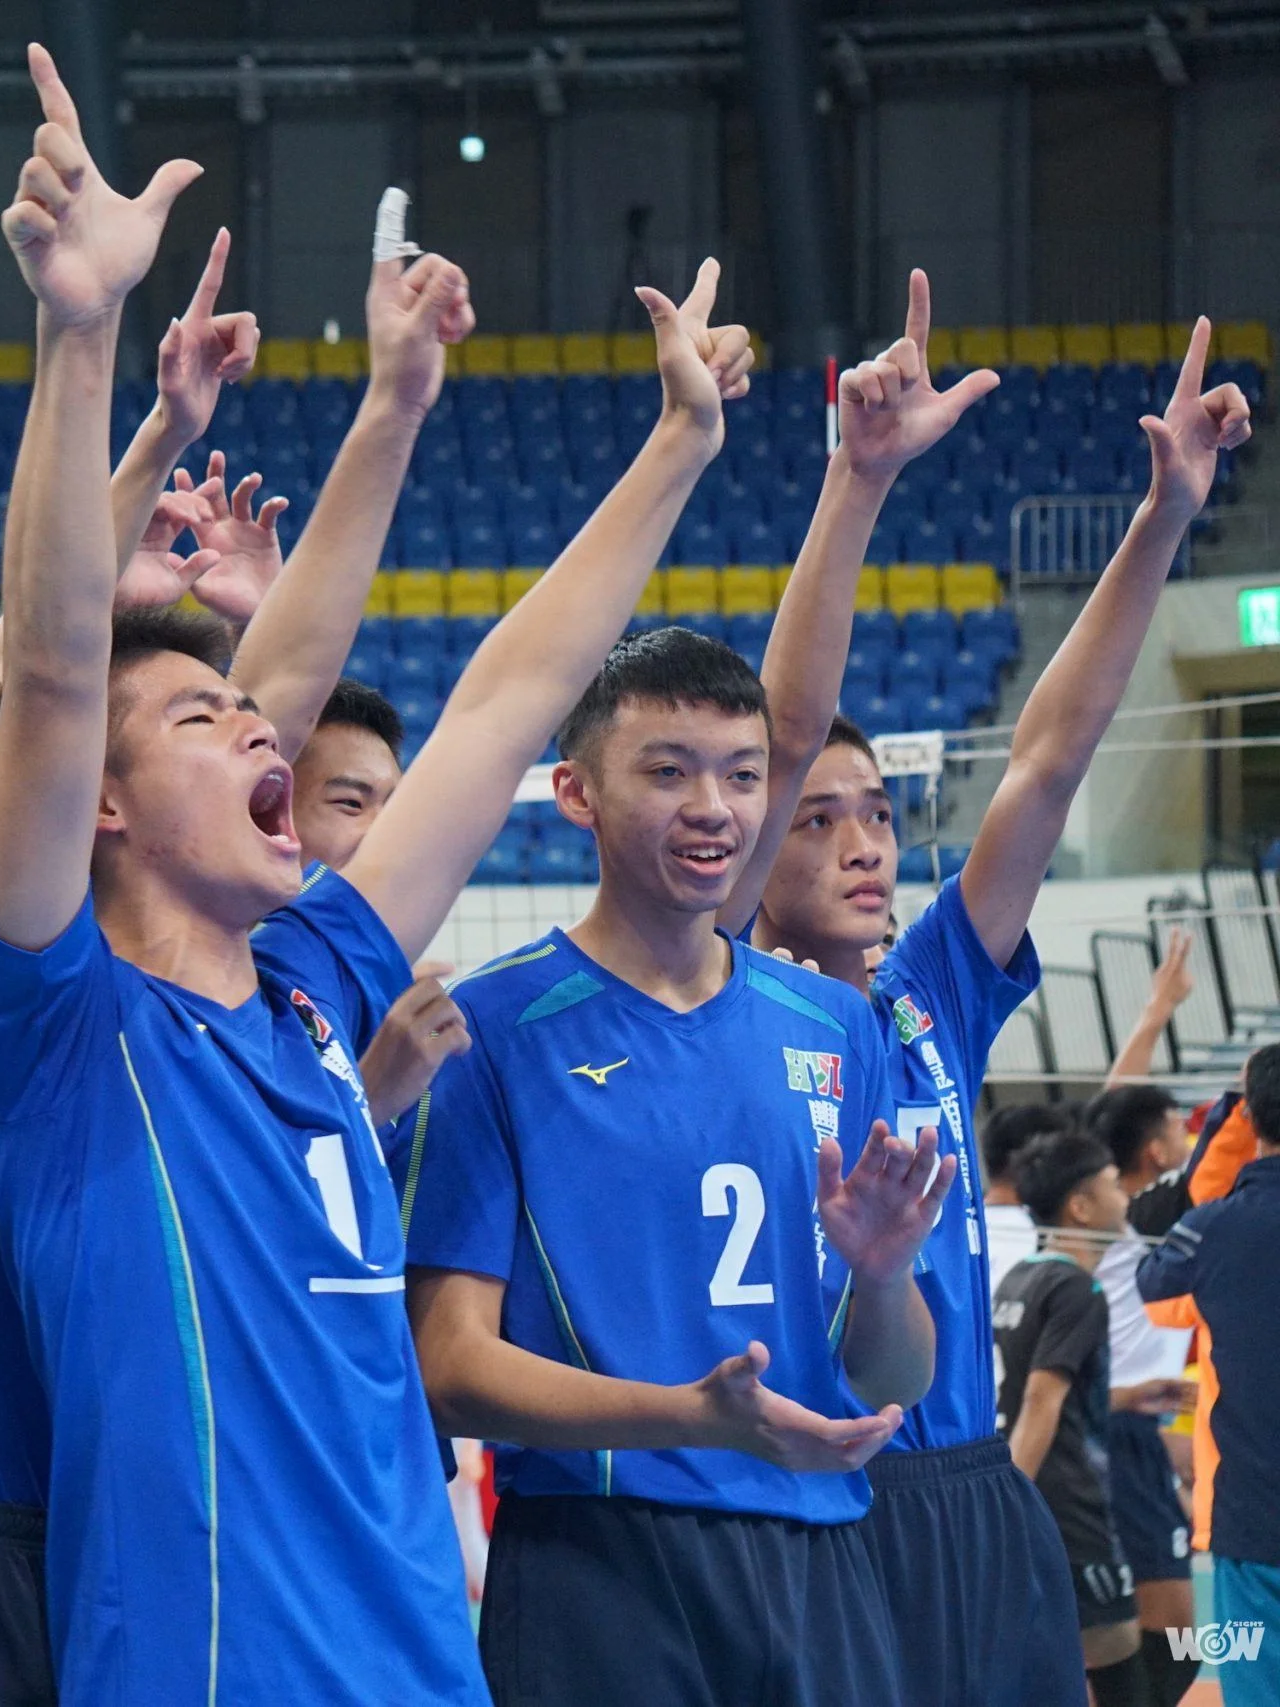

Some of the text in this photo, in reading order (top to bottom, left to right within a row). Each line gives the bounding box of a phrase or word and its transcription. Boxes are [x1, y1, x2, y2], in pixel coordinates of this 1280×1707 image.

[782, 1046, 844, 1102] HVL
[305, 1134, 384, 1270] 1
[701, 1163, 774, 1306] 2
